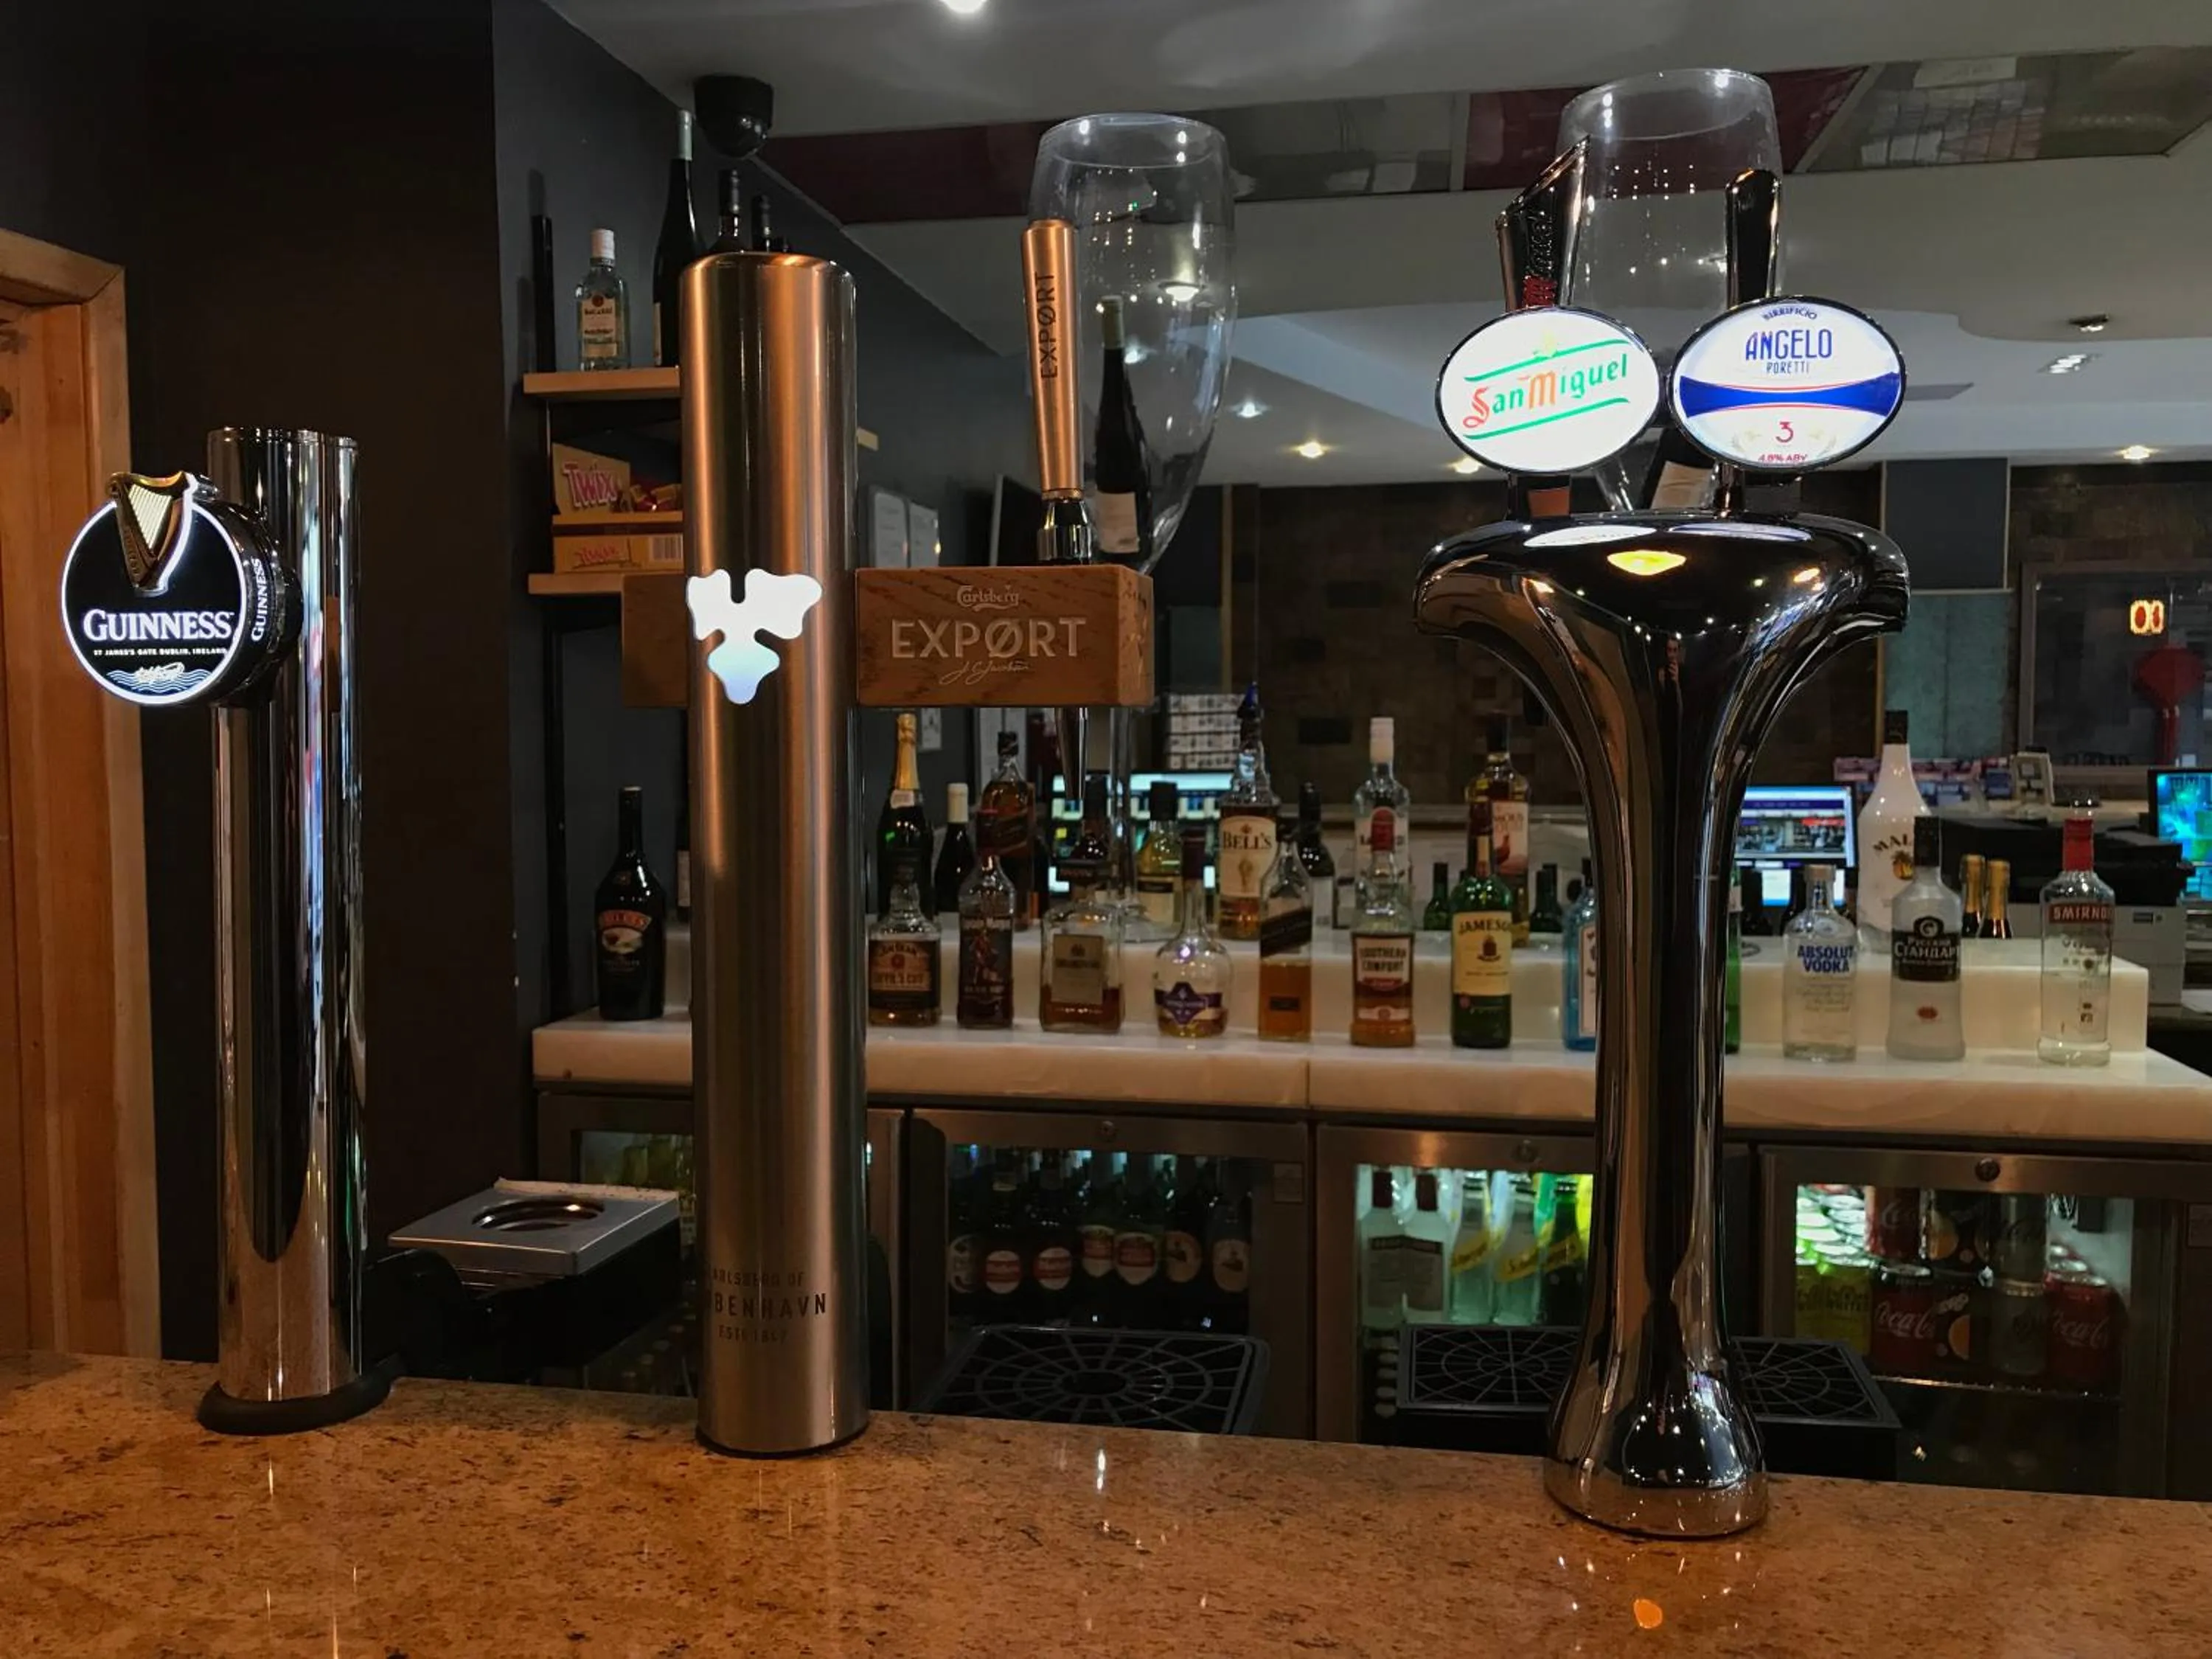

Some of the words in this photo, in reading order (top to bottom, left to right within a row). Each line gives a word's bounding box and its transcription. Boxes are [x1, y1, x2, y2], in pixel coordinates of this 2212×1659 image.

[1745, 329, 1833, 361] ANGELO
[1767, 361, 1809, 375] PORETTI
[1463, 385, 1524, 428] San
[1517, 353, 1627, 410] Miguel
[1774, 420, 1794, 443] 3
[251, 556, 268, 642] GUINNESS
[957, 585, 1019, 612] Carlsberg
[83, 609, 232, 641] GUINNESS
[1222, 830, 1272, 849] BELL'S
[1874, 834, 1913, 851] MAL
[2053, 905, 2111, 921] SMIRNO
[1459, 918, 1512, 933] JAMESO
[1797, 945, 1854, 959] ABSOLUT
[1803, 959, 1850, 973] VODKA
[712, 1292, 826, 1319] BENHAVN
